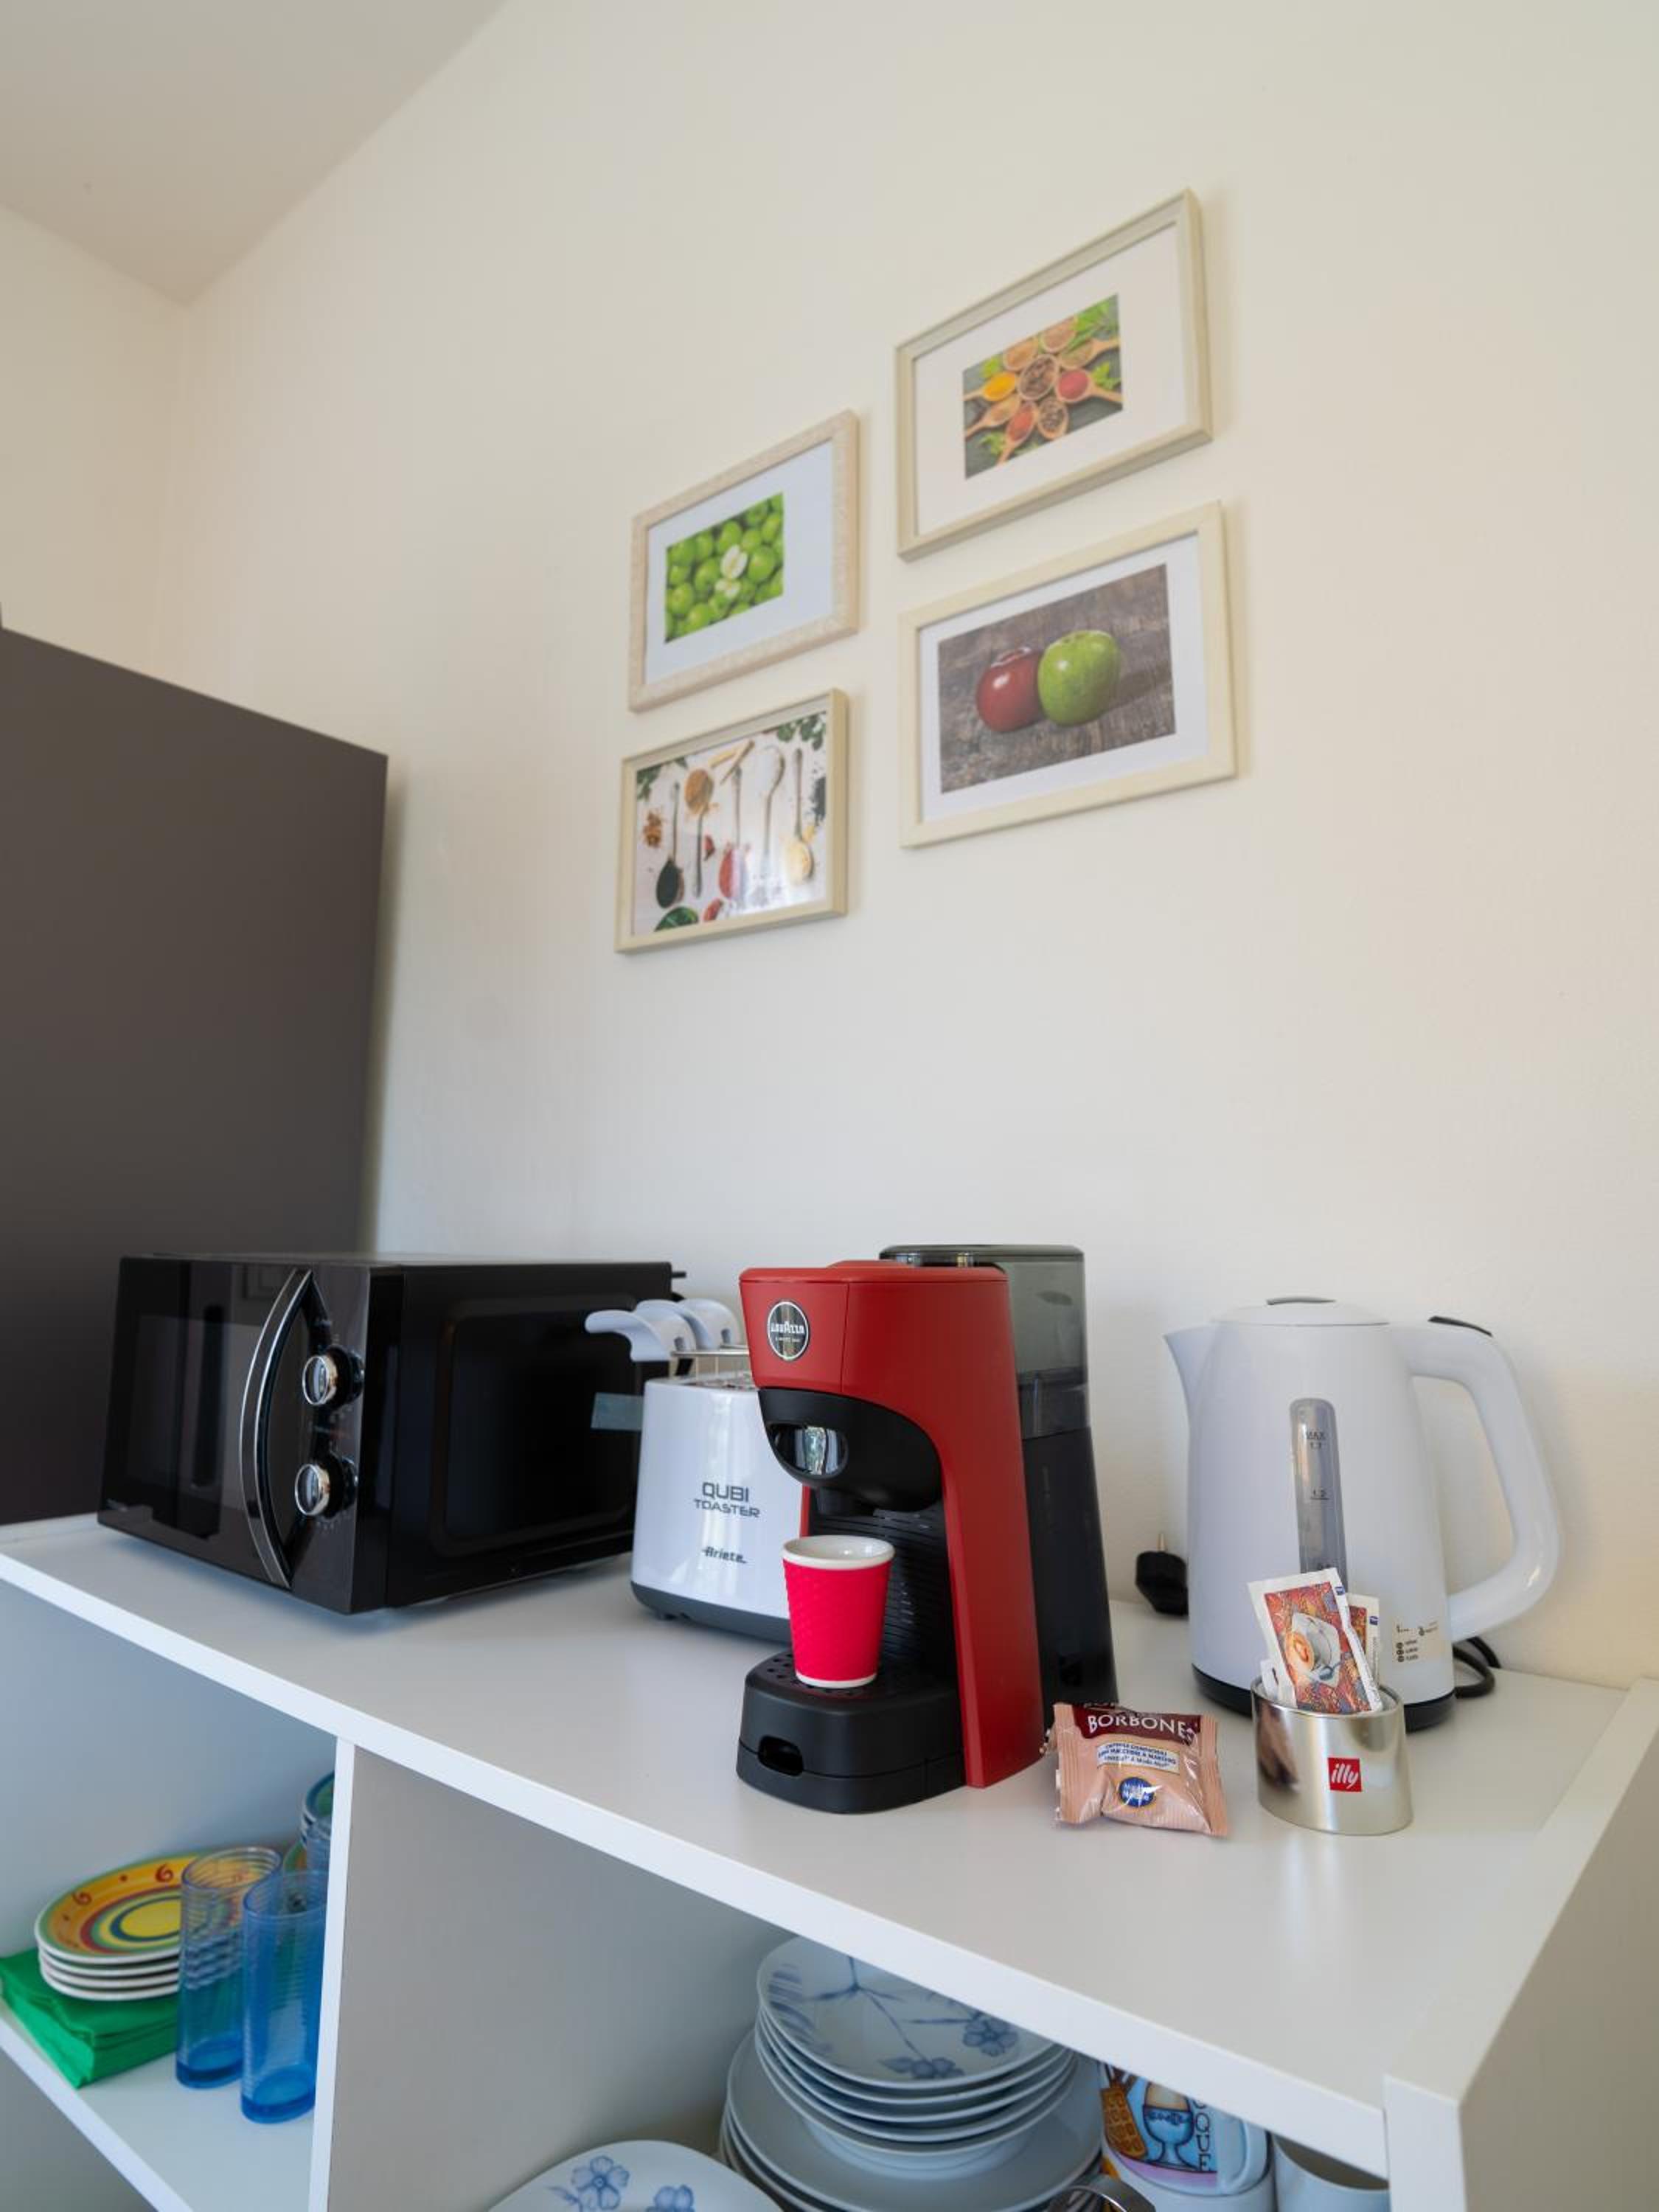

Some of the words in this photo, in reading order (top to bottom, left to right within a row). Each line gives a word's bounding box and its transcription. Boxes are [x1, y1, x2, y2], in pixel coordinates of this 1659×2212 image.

[702, 1481, 750, 1503] QUBI
[693, 1498, 760, 1518] TOASTER
[1088, 1714, 1188, 1740] BORBONE
[1331, 1763, 1359, 1789] illy
